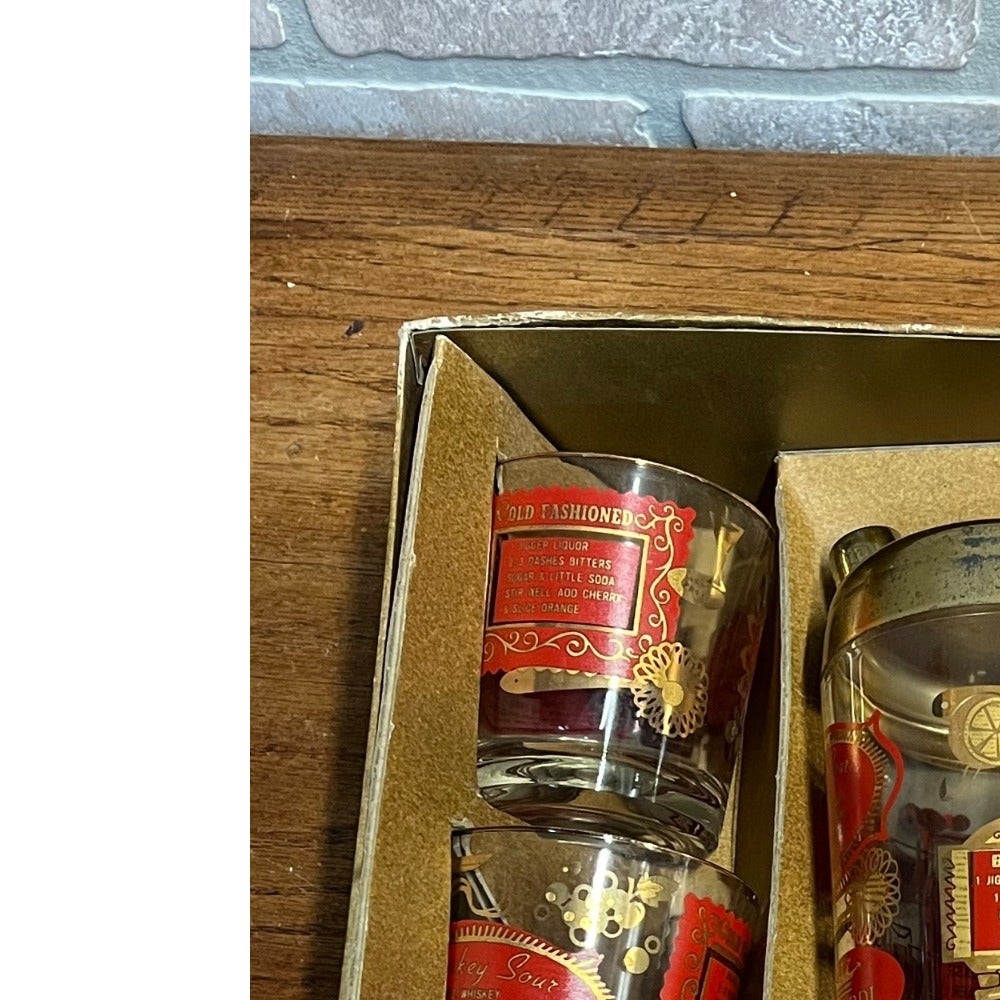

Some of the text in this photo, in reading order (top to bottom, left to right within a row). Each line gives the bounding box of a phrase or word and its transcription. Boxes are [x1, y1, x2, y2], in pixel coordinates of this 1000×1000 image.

[542, 502, 633, 526] FASHIONED
[570, 557, 612, 570] BITTERS
[588, 574, 615, 585] SODA
[558, 588, 577, 598] ADD
[542, 604, 579, 614] ORANGE
[976, 876, 980, 885] 1
[995, 894, 998, 902] 1
[496, 954, 559, 992] Sour
